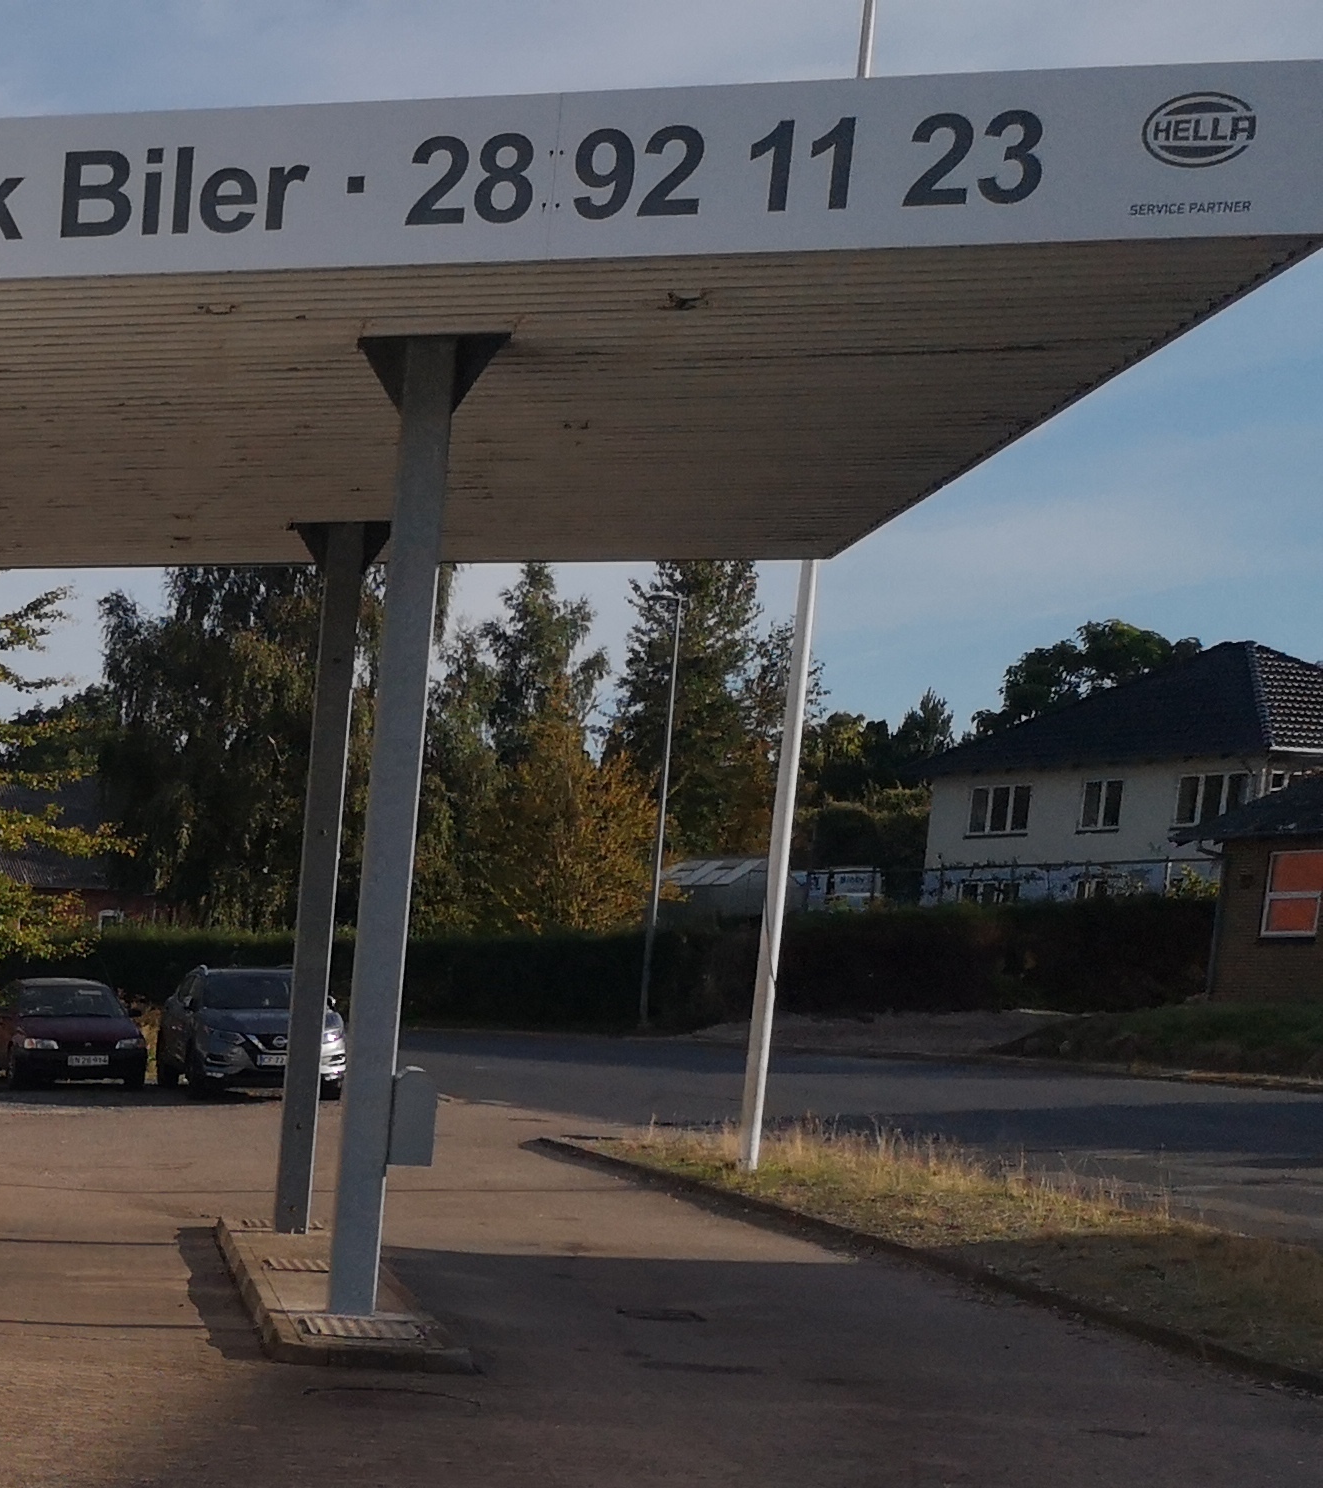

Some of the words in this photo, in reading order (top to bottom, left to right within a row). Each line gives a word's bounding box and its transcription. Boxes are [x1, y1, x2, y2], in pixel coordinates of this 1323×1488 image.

[1154, 116, 1256, 141] HELLA
[60, 146, 310, 238] Biler
[405, 133, 534, 225] 28
[573, 125, 704, 220] 92
[750, 117, 856, 212] 11
[901, 109, 1043, 206] 23
[1129, 203, 1185, 216] SERVICE
[1189, 201, 1252, 213] PARTNER
